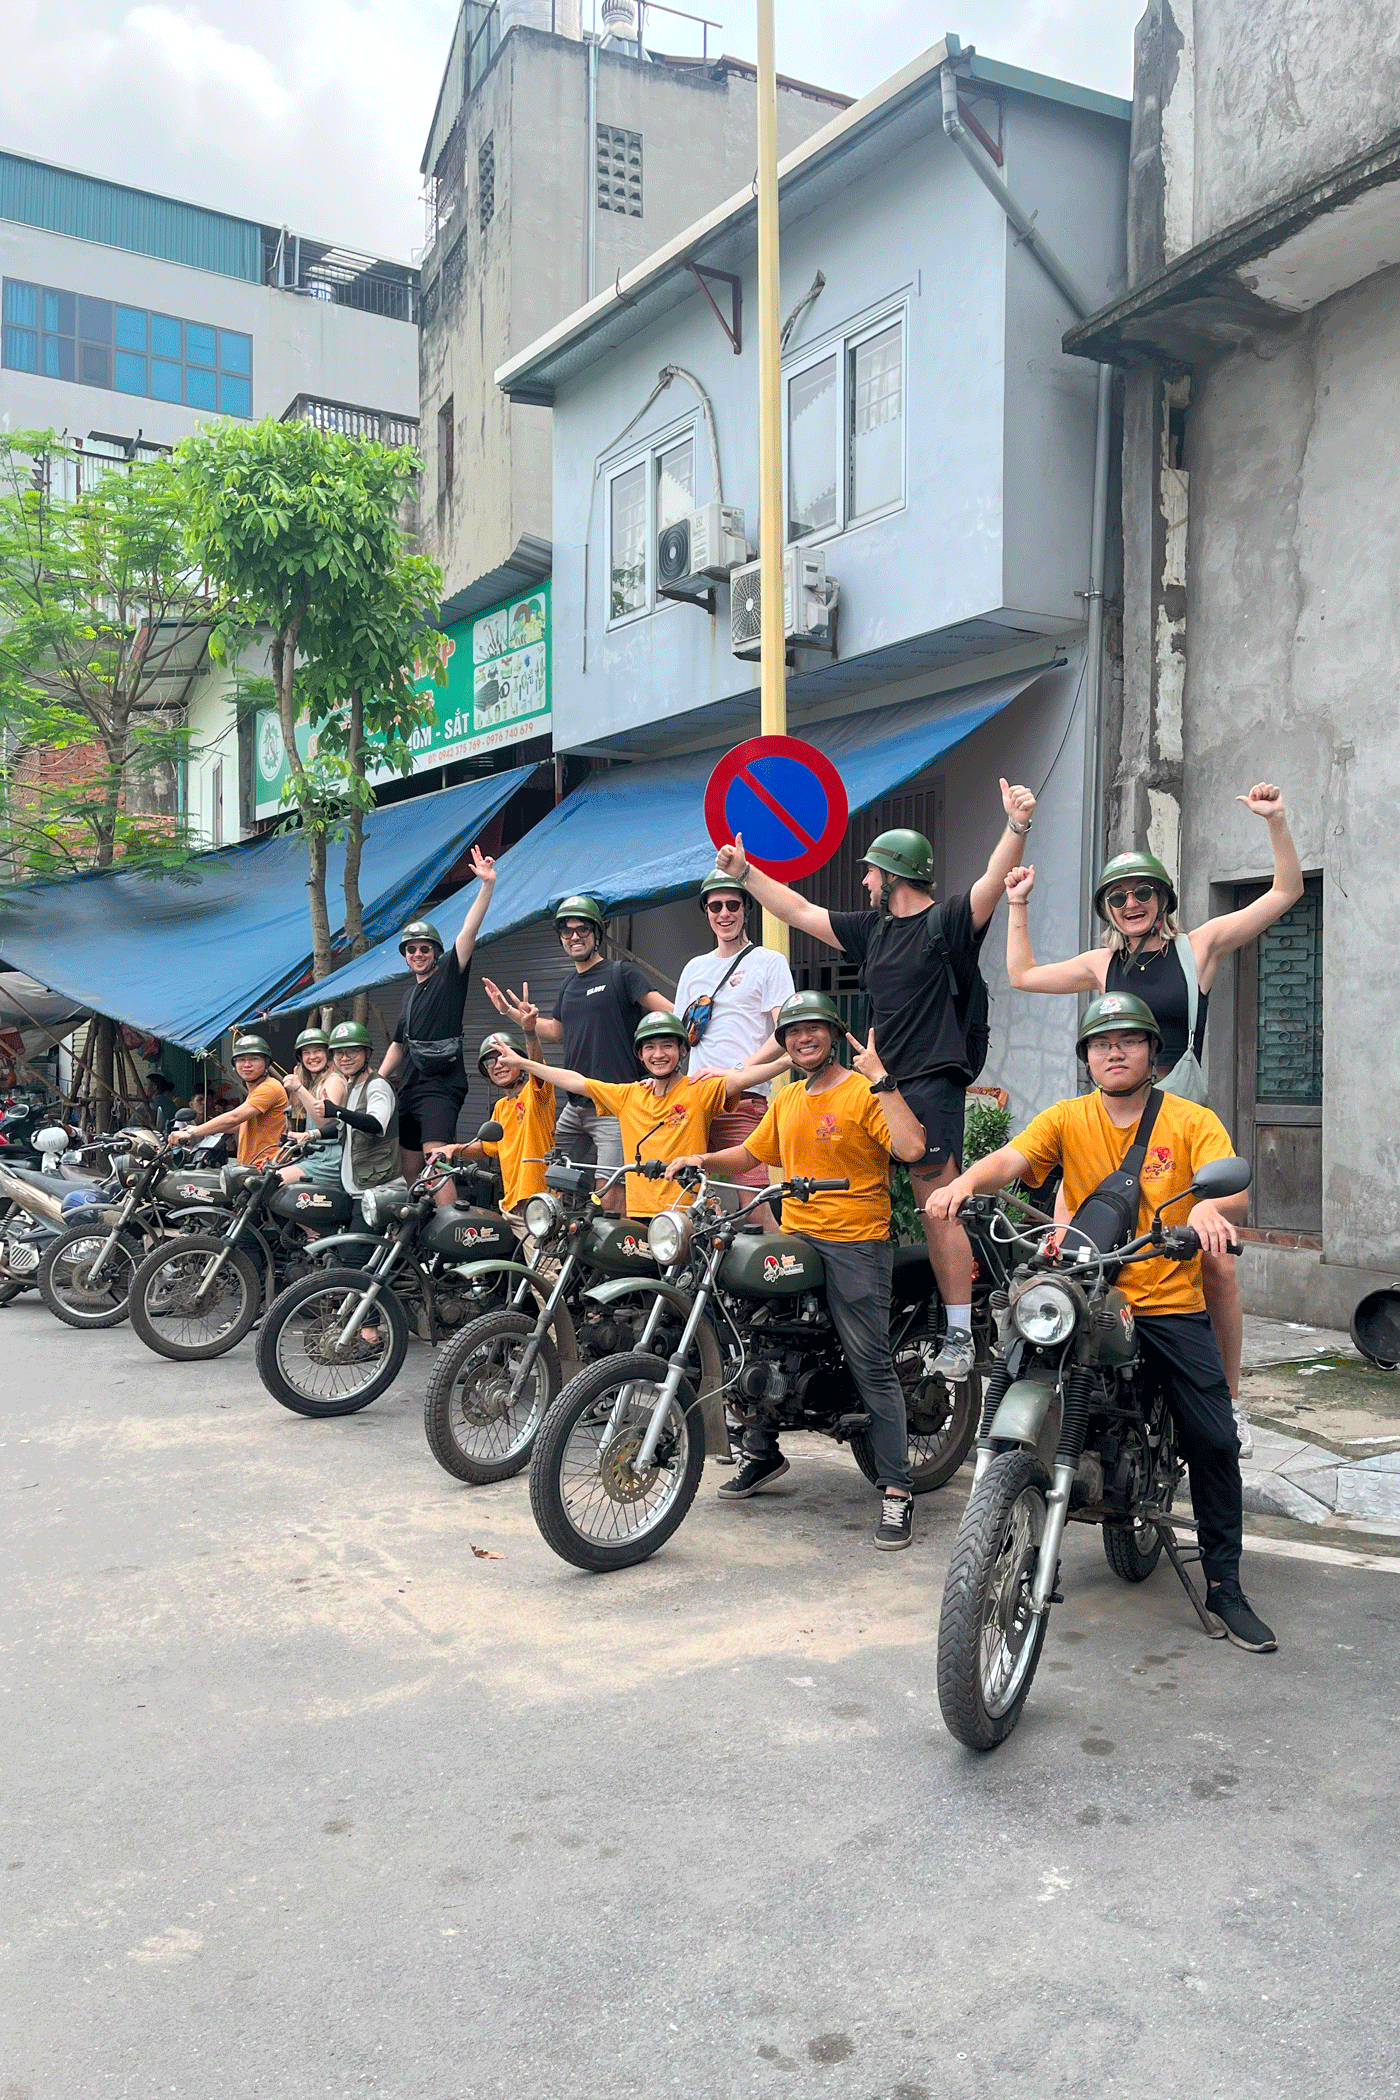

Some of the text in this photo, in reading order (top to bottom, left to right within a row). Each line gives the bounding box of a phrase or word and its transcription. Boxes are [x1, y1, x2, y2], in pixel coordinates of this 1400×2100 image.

[438, 749, 454, 761] 0942
[455, 744, 467, 756] 375
[469, 739, 481, 752] 769
[486, 732, 503, 746] 0976
[505, 727, 518, 740] 740
[519, 722, 534, 735] 679
[444, 707, 470, 740] SẮT
